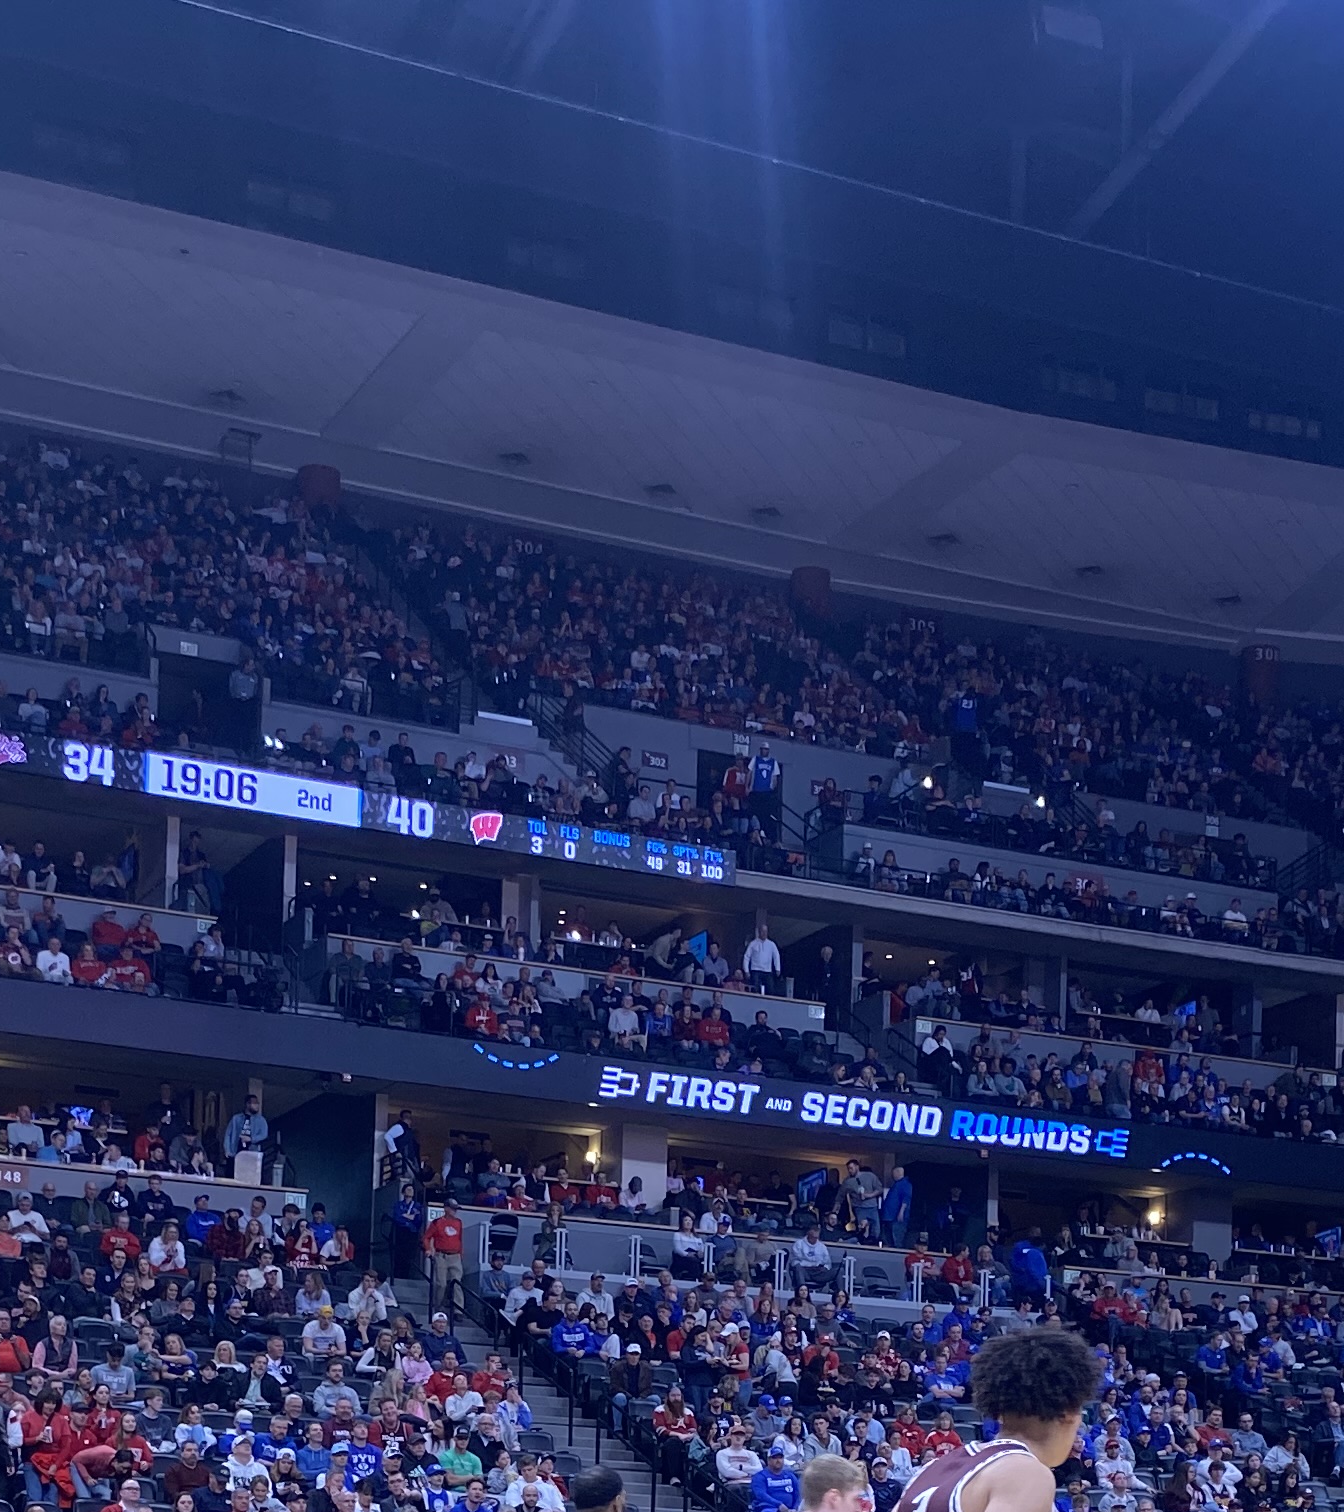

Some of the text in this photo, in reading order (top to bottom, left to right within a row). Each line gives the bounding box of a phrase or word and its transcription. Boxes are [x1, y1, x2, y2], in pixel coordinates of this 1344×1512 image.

[63, 739, 116, 788] 34
[159, 757, 333, 813] 19:06 2nd
[387, 796, 435, 839] 40
[527, 817, 548, 836] TOL
[559, 824, 580, 841] FLS
[592, 829, 631, 848] BONUS
[703, 849, 724, 864] FT%
[530, 835, 544, 855] 3
[563, 840, 577, 860] 0
[700, 863, 723, 881] 100
[646, 1071, 1093, 1156] FIRST AND SECOND ROUNDS
